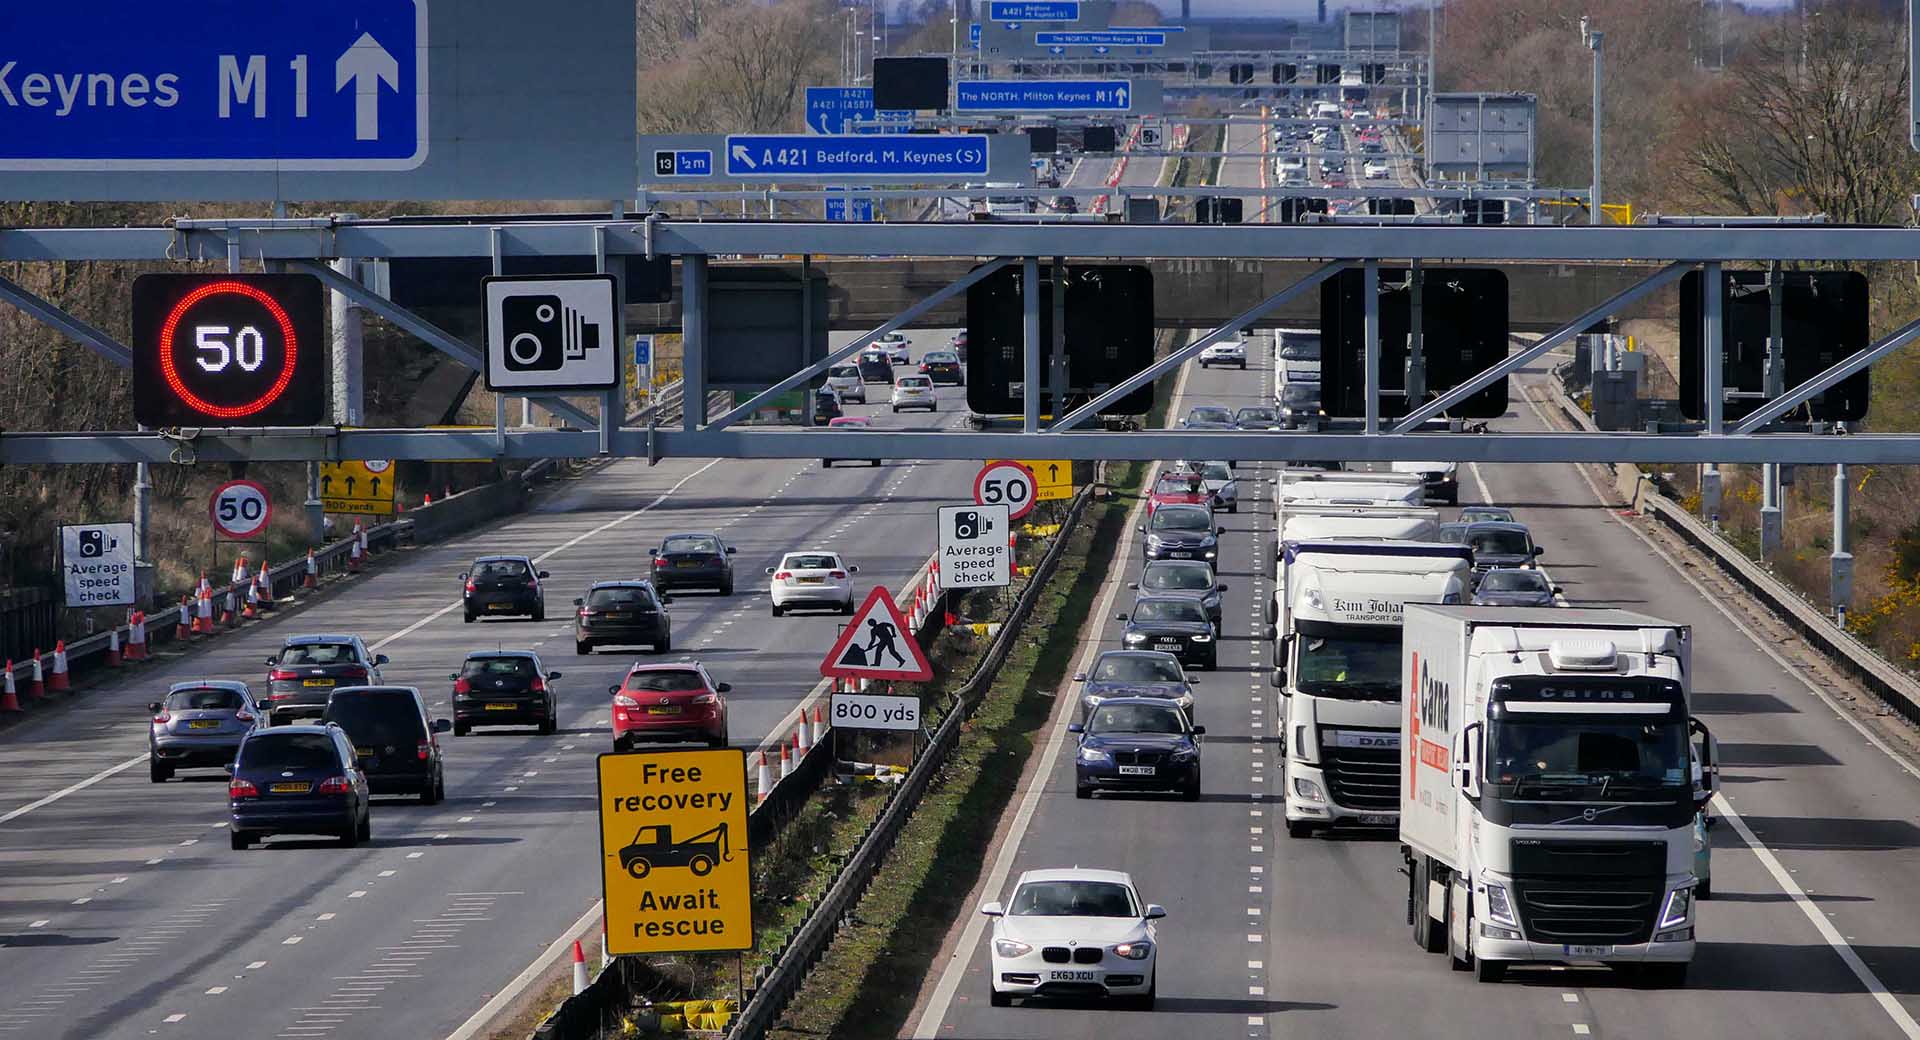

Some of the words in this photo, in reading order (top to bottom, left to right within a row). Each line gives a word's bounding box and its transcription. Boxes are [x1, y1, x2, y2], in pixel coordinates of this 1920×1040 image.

[844, 90, 866, 98] A421
[961, 92, 978, 101] The
[1023, 91, 1054, 101] Milton
[1057, 92, 1091, 103] Keynes
[882, 151, 898, 163] M.
[659, 158, 672, 169] 13
[195, 326, 263, 372] 50
[985, 479, 1027, 503] 50
[220, 497, 262, 521] 50
[946, 545, 1003, 556] Average
[71, 563, 128, 575] Average
[954, 558, 995, 571] speed
[79, 576, 120, 589] speed
[954, 571, 995, 583] check
[80, 590, 120, 601] check
[1421, 658, 1449, 733] Carna
[1539, 687, 1635, 699] Carna
[836, 703, 877, 719] 800
[883, 705, 915, 723] yds
[1360, 737, 1400, 746] DAF
[642, 764, 702, 785] Free
[614, 792, 733, 813] recovery
[640, 888, 721, 912] Await
[634, 919, 725, 938] rescue
[1051, 971, 1074, 980] EK63
[1076, 971, 1094, 980] XCU
